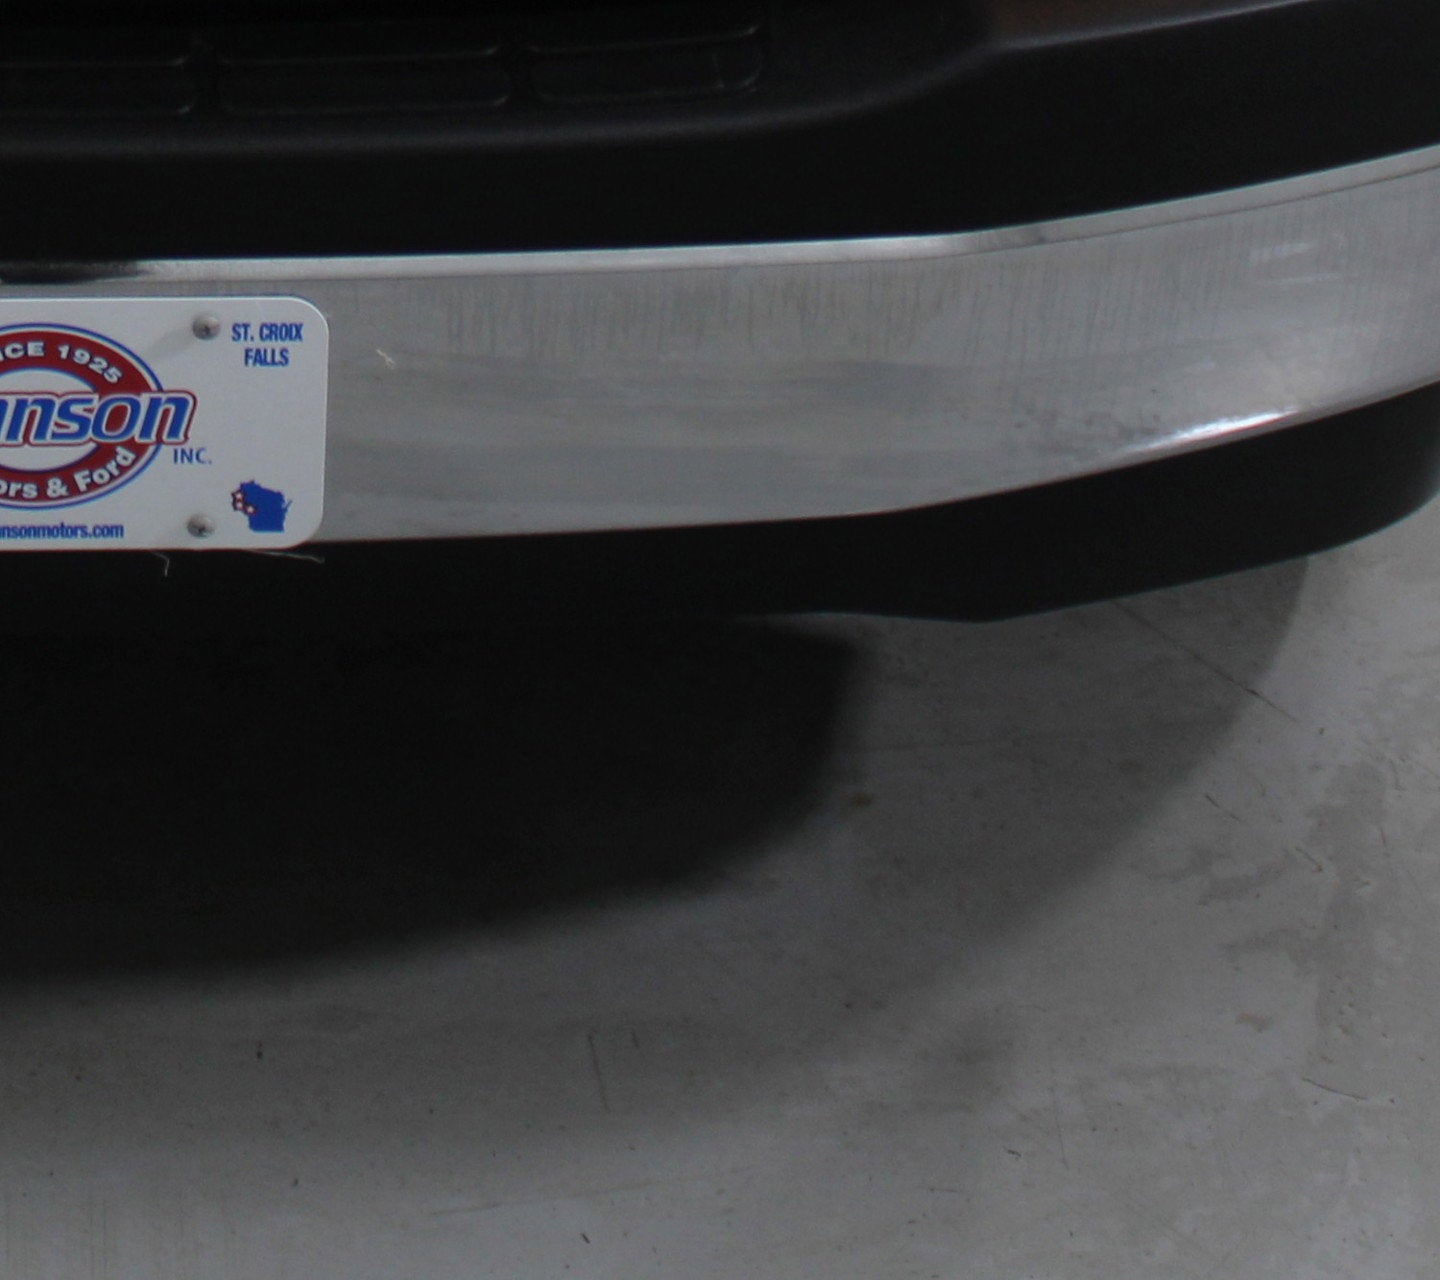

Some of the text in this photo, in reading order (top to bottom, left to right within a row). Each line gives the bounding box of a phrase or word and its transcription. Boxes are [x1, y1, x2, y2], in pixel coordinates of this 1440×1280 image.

[231, 322, 304, 343] ST. CROIX
[58, 344, 123, 384] 1925
[244, 347, 290, 367] FALLS
[173, 447, 213, 465] INC.
[46, 476, 69, 499] &
[72, 445, 137, 493] Ford
